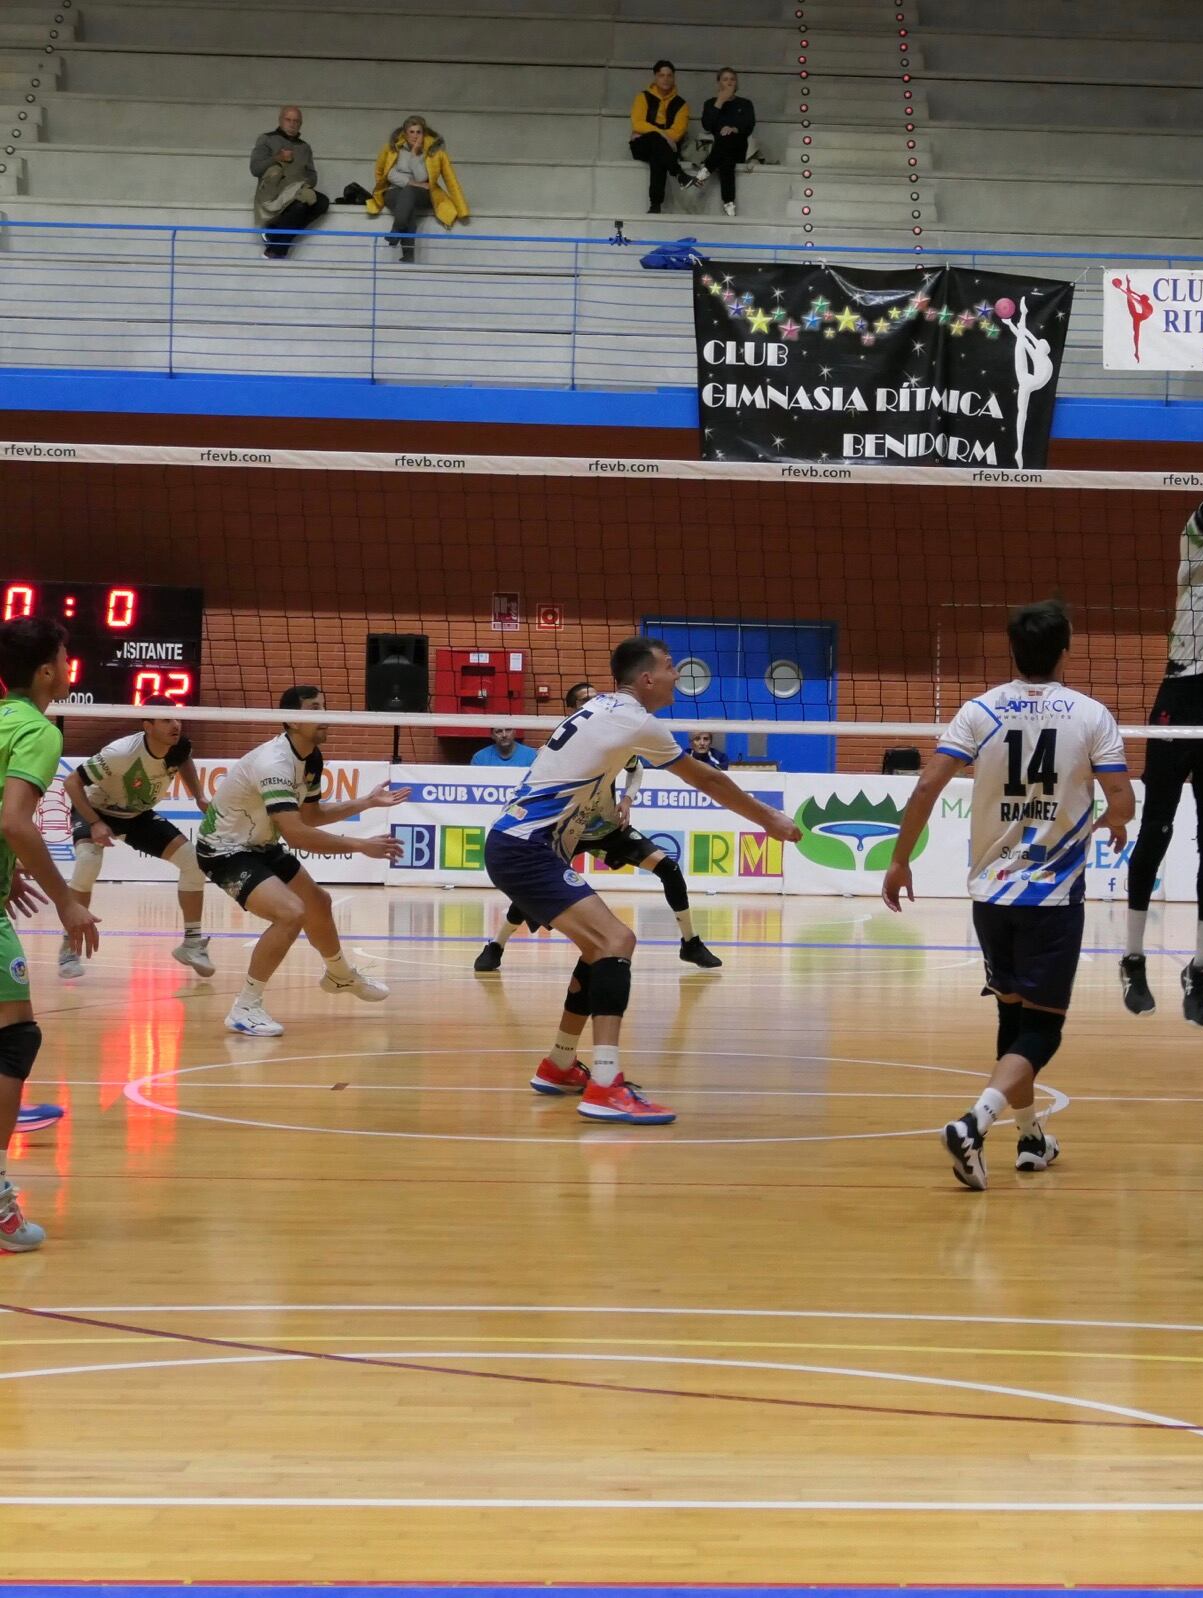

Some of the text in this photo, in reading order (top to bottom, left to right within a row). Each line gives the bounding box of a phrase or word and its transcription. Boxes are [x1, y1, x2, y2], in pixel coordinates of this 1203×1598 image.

[703, 340, 788, 367] CLUB
[702, 381, 1004, 419] GIMNASIA RÍTMICA
[4, 445, 76, 458] rfevb.com
[200, 450, 271, 464] rfevb.com
[842, 432, 999, 466] BENIDORM
[394, 456, 466, 469] rfevb.com
[589, 461, 659, 474] rfevb.com
[781, 466, 851, 479] rfevb.com
[972, 471, 1042, 484] rfevb.com
[108, 590, 134, 626] 0
[1003, 729, 1058, 797] 14
[422, 785, 468, 802] CLUB
[471, 786, 517, 803] VOLE
[657, 791, 745, 808] BENID
[1000, 797, 1058, 822] RAMÍREZ
